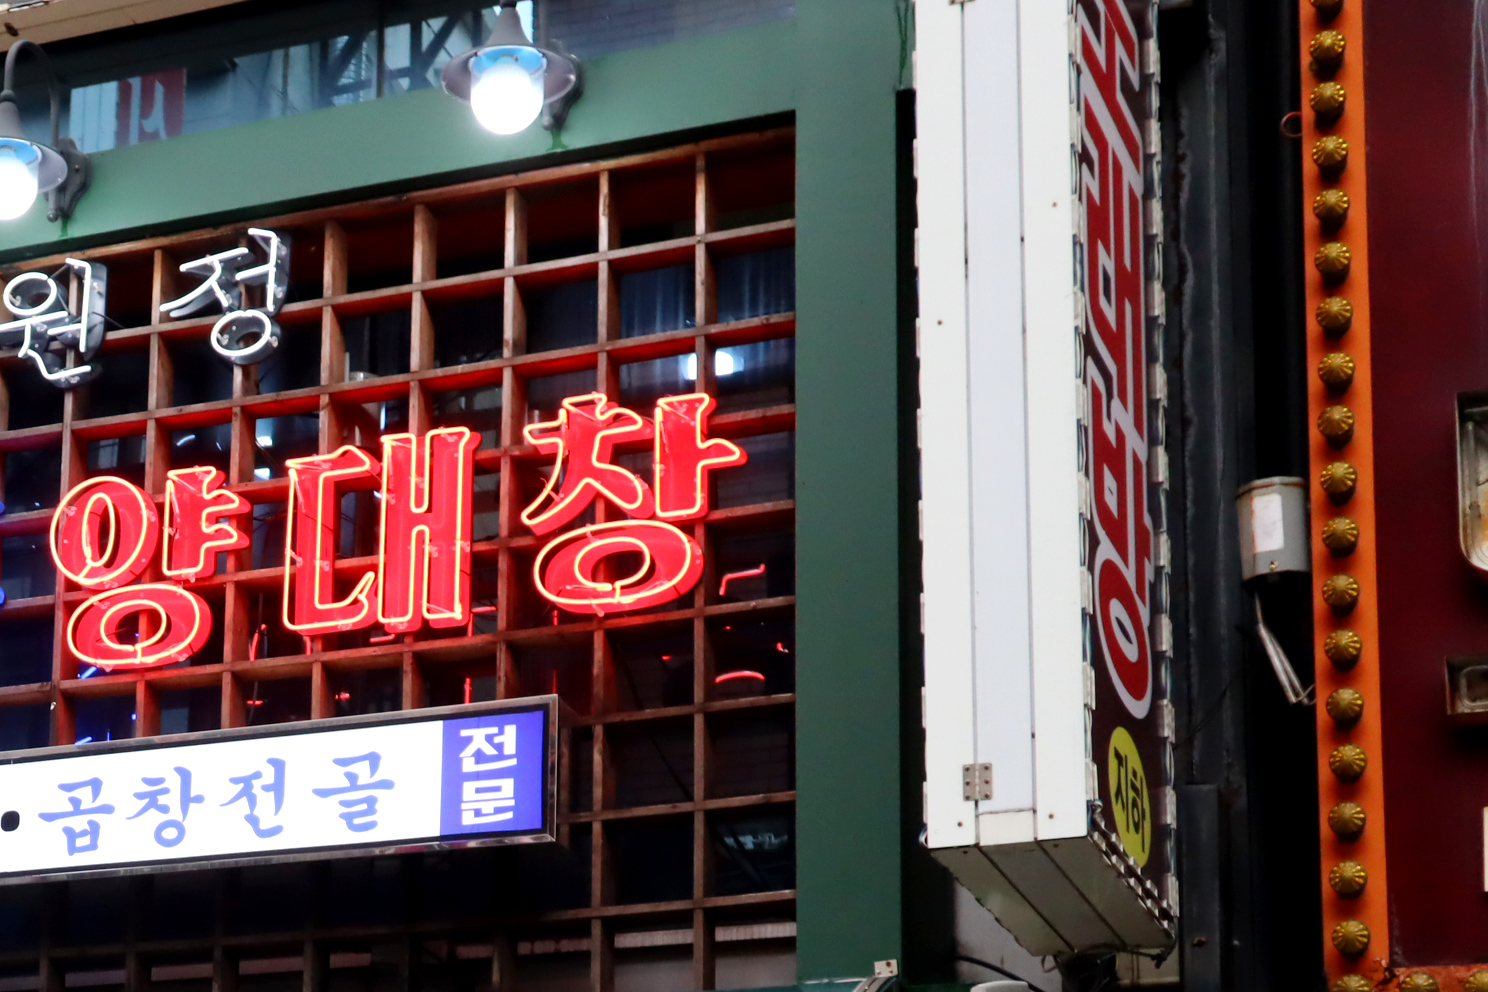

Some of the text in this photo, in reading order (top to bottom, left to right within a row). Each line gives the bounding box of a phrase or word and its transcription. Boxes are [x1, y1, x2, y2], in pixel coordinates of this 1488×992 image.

[50, 392, 749, 671] 양대창
[458, 724, 519, 827] 전문
[1114, 745, 1147, 854] 지하
